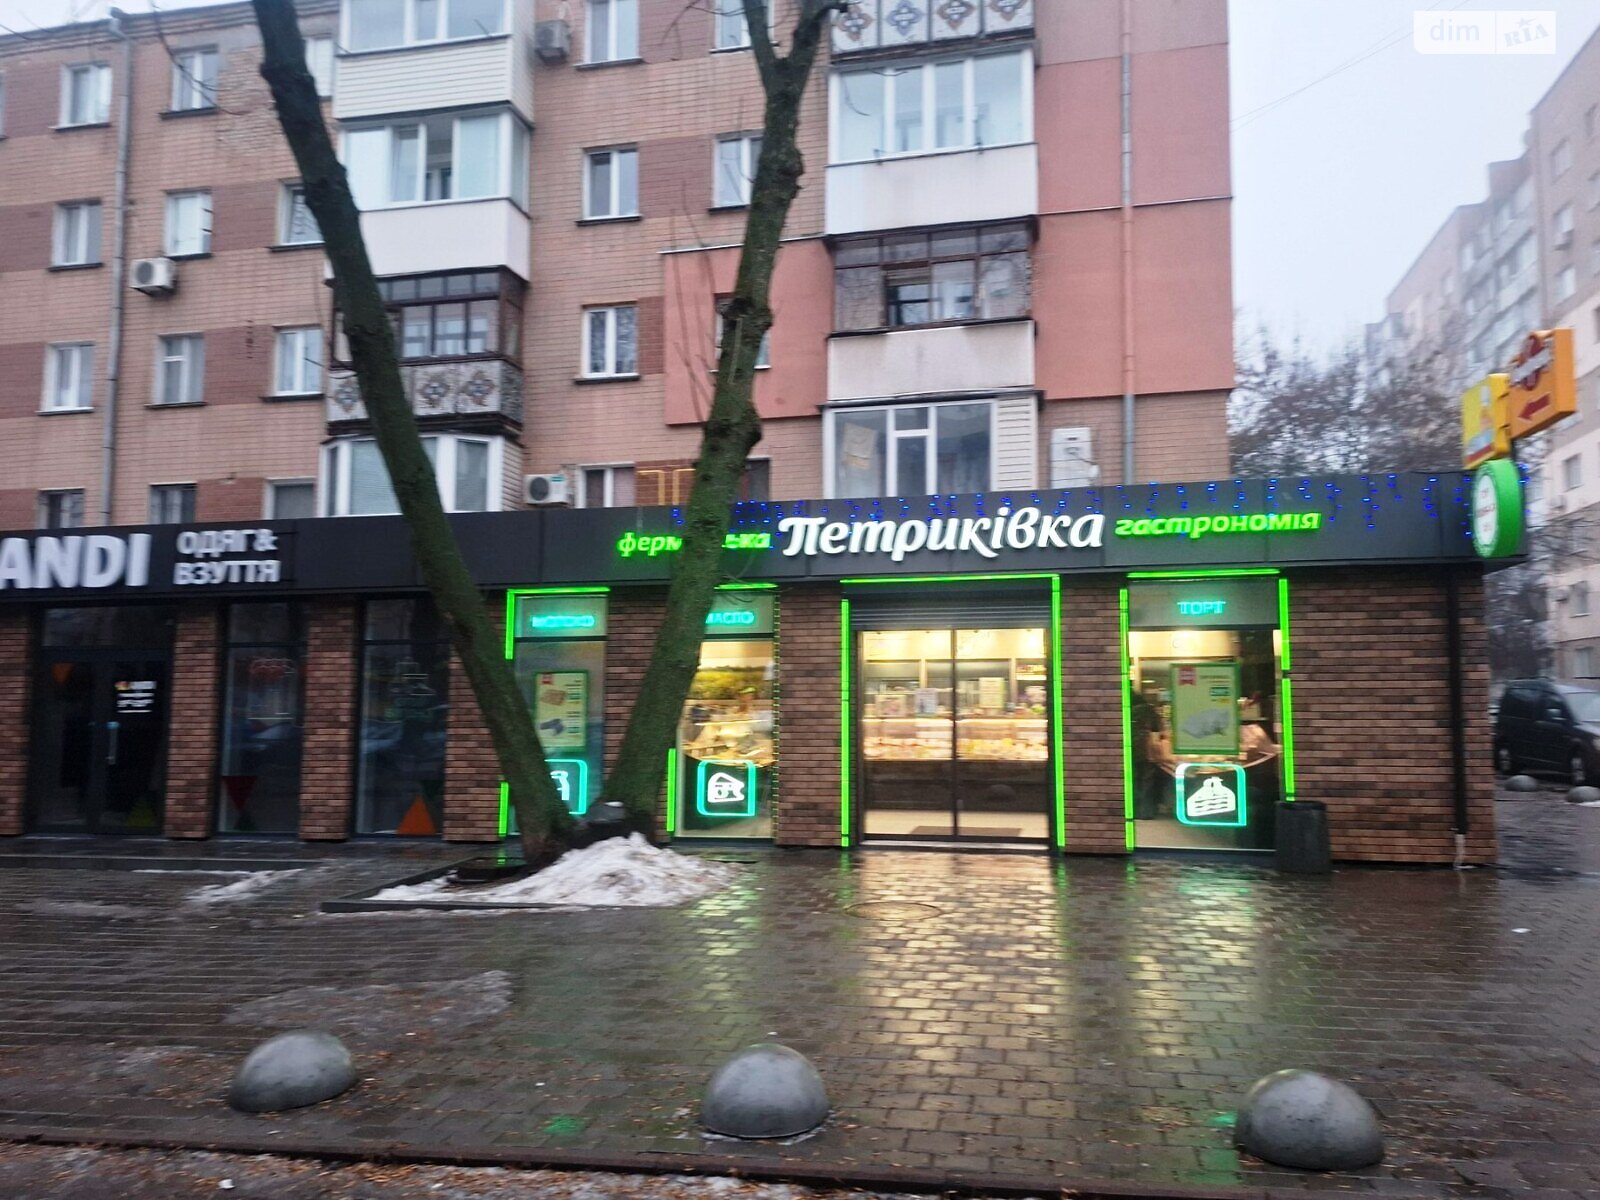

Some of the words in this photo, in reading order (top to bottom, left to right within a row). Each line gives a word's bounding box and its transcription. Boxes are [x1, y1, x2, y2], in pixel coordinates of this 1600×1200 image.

[618, 532, 771, 557] фермька
[778, 506, 1105, 562] Петриківка
[1115, 513, 1321, 538] гастрономія
[173, 560, 281, 585] ВЗУТТЯ
[1177, 600, 1226, 615] ТОРТ
